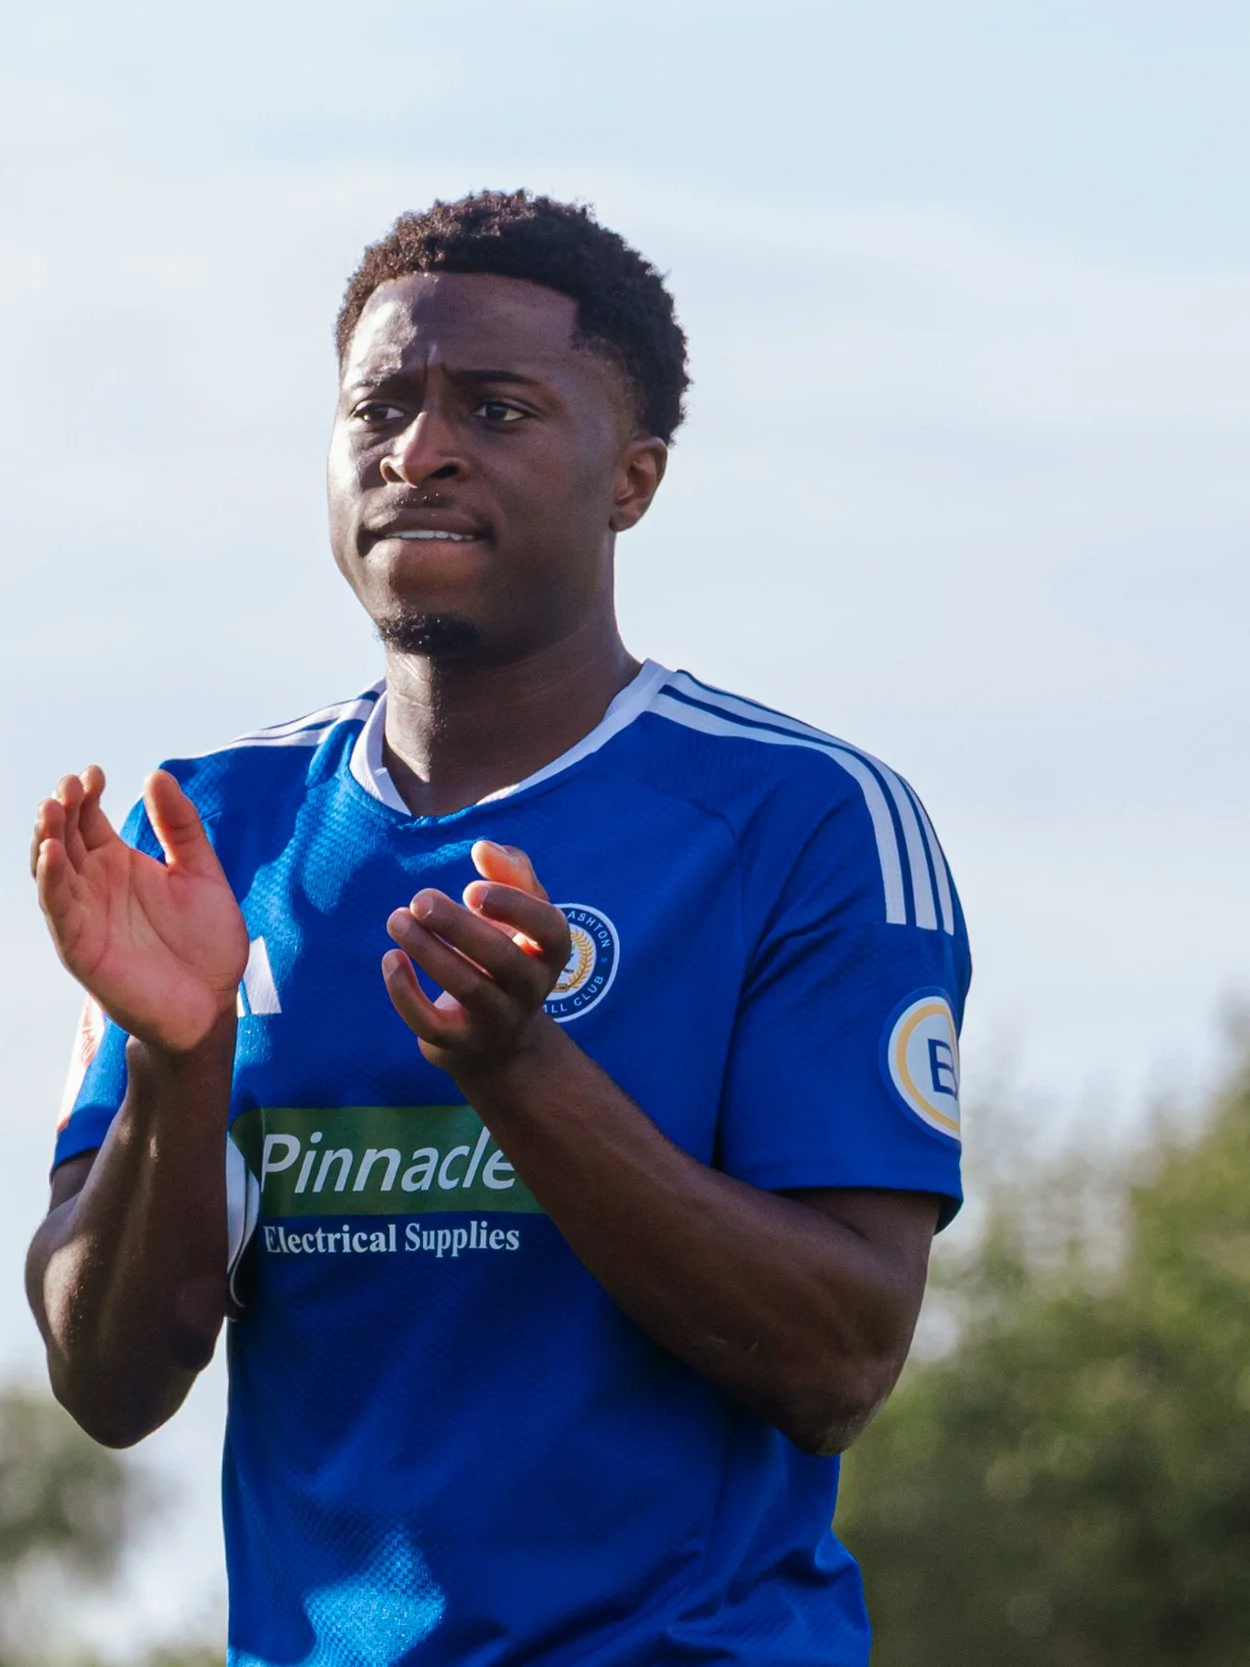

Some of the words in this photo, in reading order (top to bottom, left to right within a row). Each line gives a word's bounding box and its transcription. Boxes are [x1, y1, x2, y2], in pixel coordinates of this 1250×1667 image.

[567, 910, 610, 948] ASHTON
[573, 975, 604, 1006] CLUB
[261, 1126, 516, 1194] Pinnacle
[263, 1224, 397, 1254] Electrical
[404, 1221, 520, 1258] Supplies
